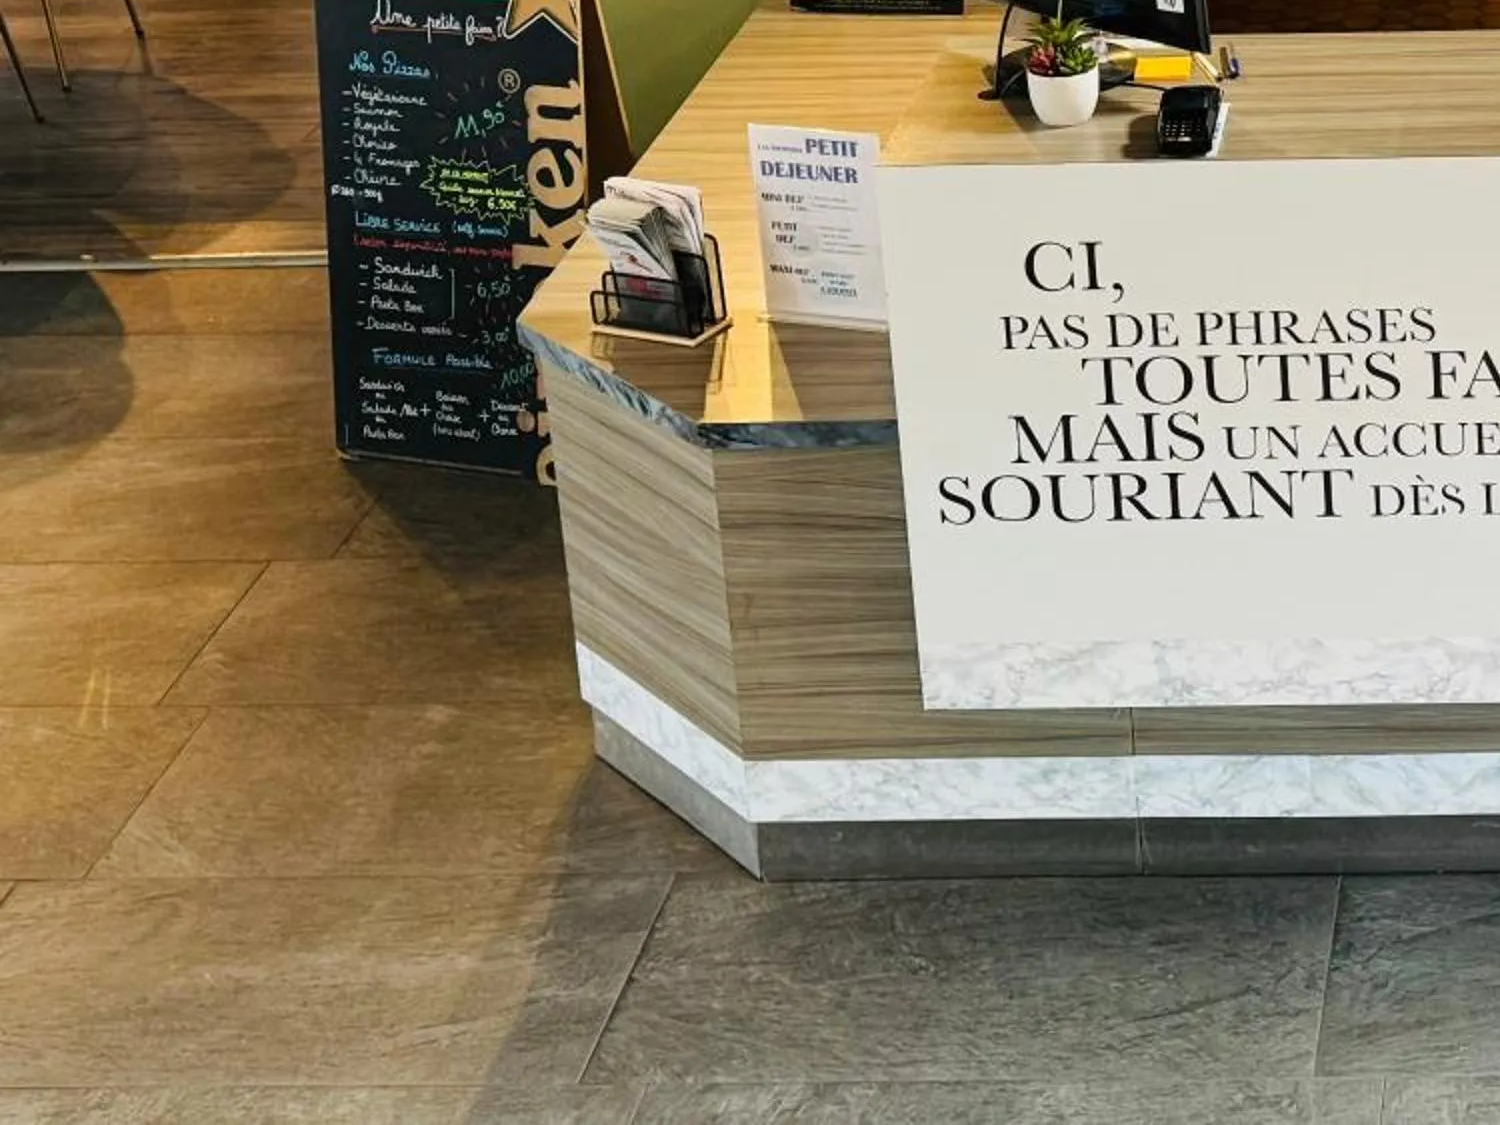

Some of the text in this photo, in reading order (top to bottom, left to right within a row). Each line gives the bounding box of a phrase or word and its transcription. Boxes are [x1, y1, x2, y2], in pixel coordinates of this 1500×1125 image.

[350, 51, 375, 73] Nos
[761, 160, 858, 184] DEJEUNER
[805, 139, 857, 157] PETIT
[1024, 240, 1125, 302] CI,
[1001, 306, 1436, 350] PAS DE PHRASES
[1081, 350, 1401, 406] TOUTES
[1008, 411, 1205, 464] MAIS
[1223, 425, 1301, 461] UN
[938, 469, 1353, 525] SOURIANT
[1370, 475, 1465, 517] DÈS
